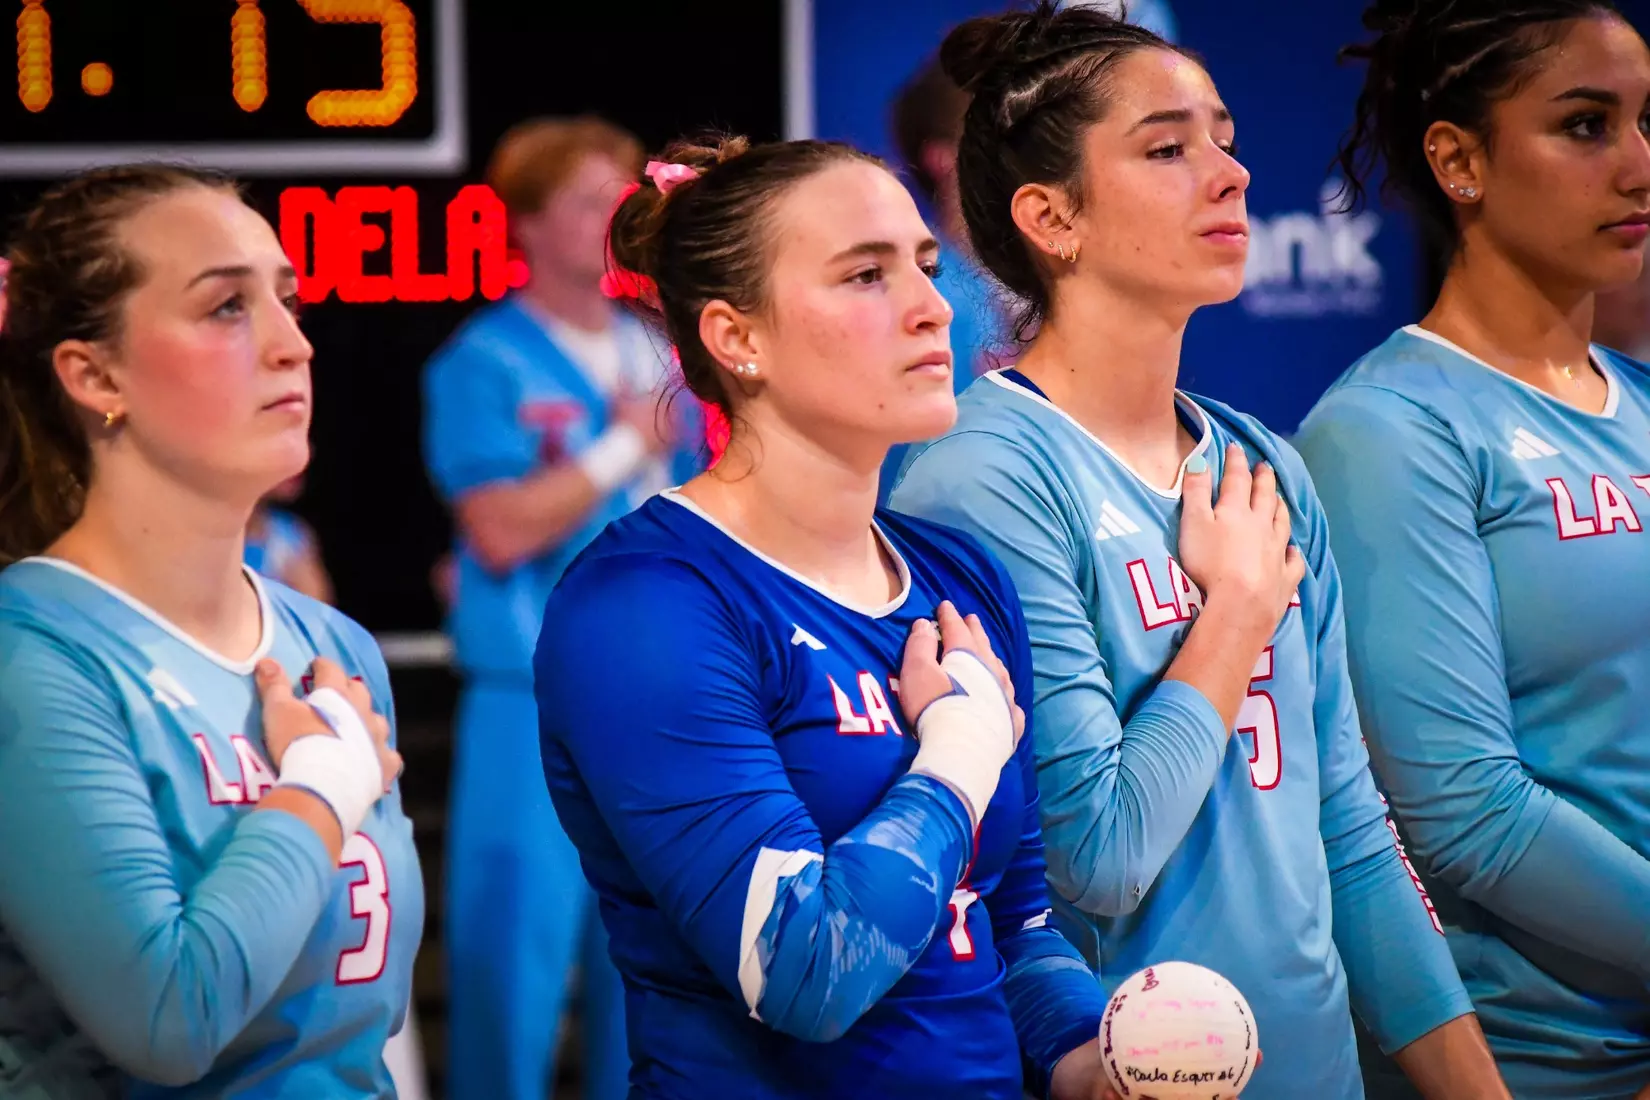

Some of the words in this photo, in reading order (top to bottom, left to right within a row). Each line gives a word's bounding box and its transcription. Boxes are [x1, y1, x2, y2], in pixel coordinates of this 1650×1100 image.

[279, 184, 530, 303] DELA
[827, 670, 903, 737] LA
[334, 831, 392, 986] 3
